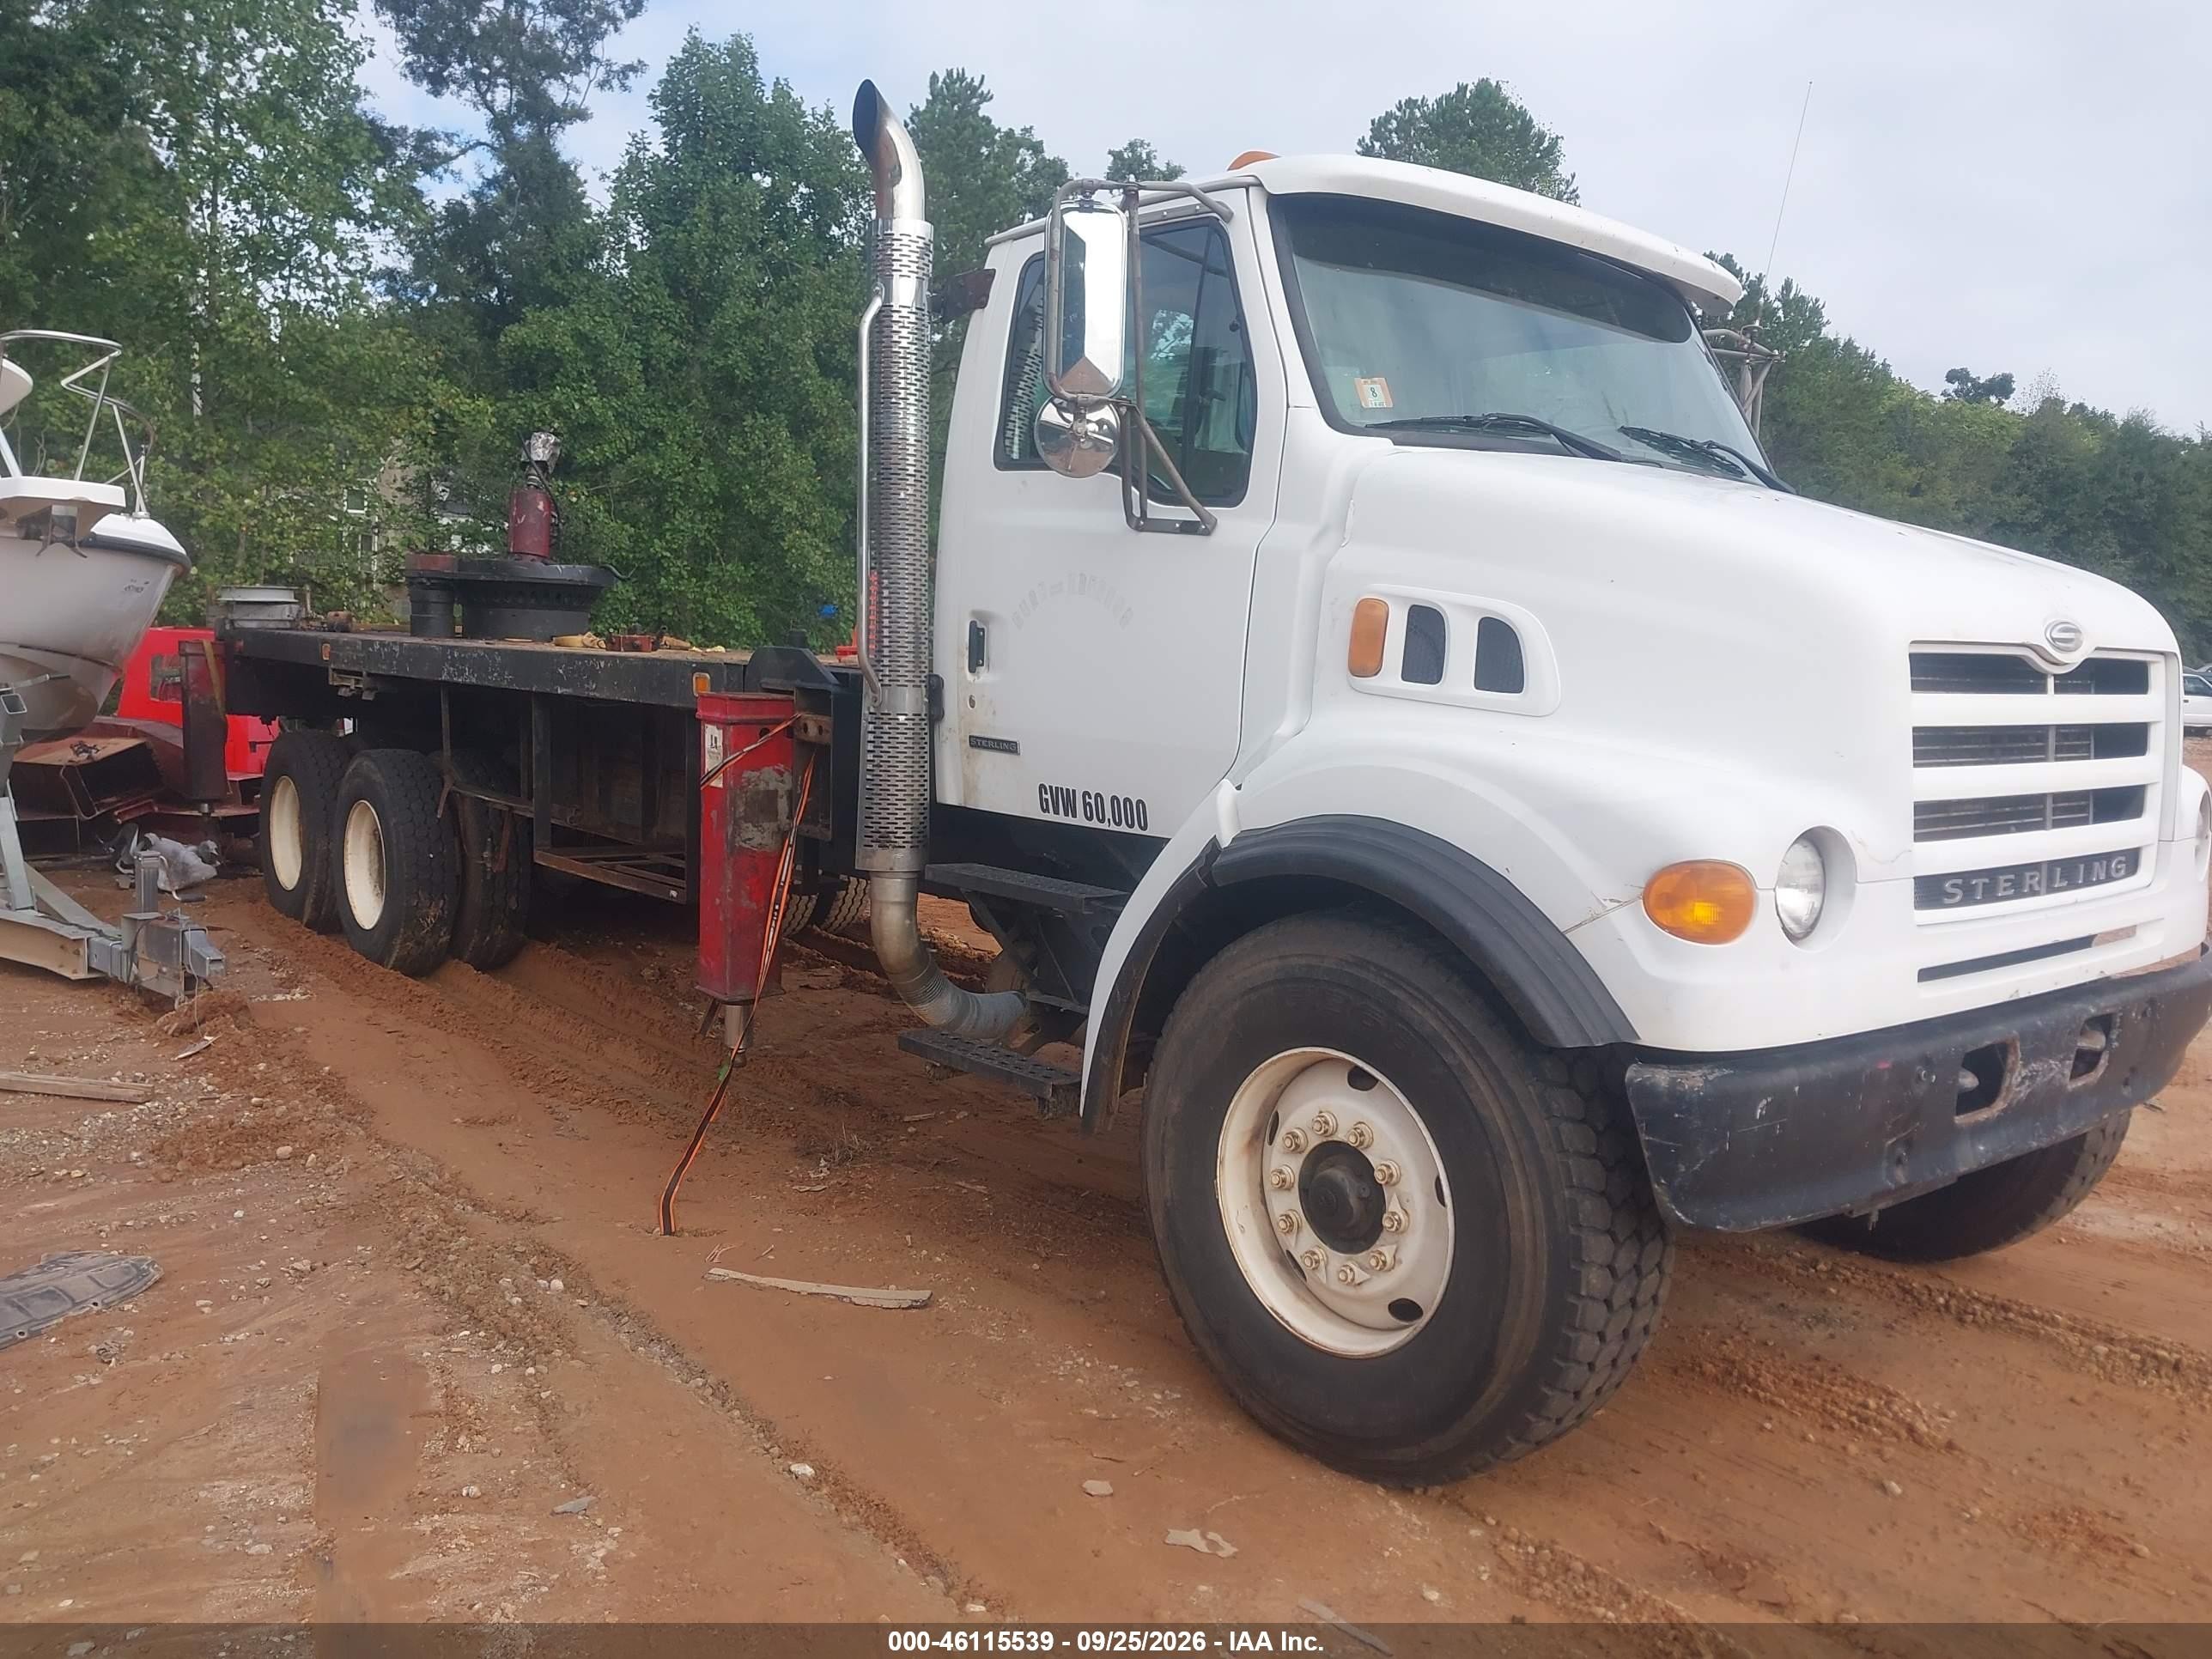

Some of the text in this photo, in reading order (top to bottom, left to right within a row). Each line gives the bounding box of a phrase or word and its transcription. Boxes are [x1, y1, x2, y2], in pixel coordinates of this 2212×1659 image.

[969, 738, 1017, 751] STERLING
[1038, 783, 1149, 831] GVW 60,000
[1943, 856, 2126, 904] STERLING
